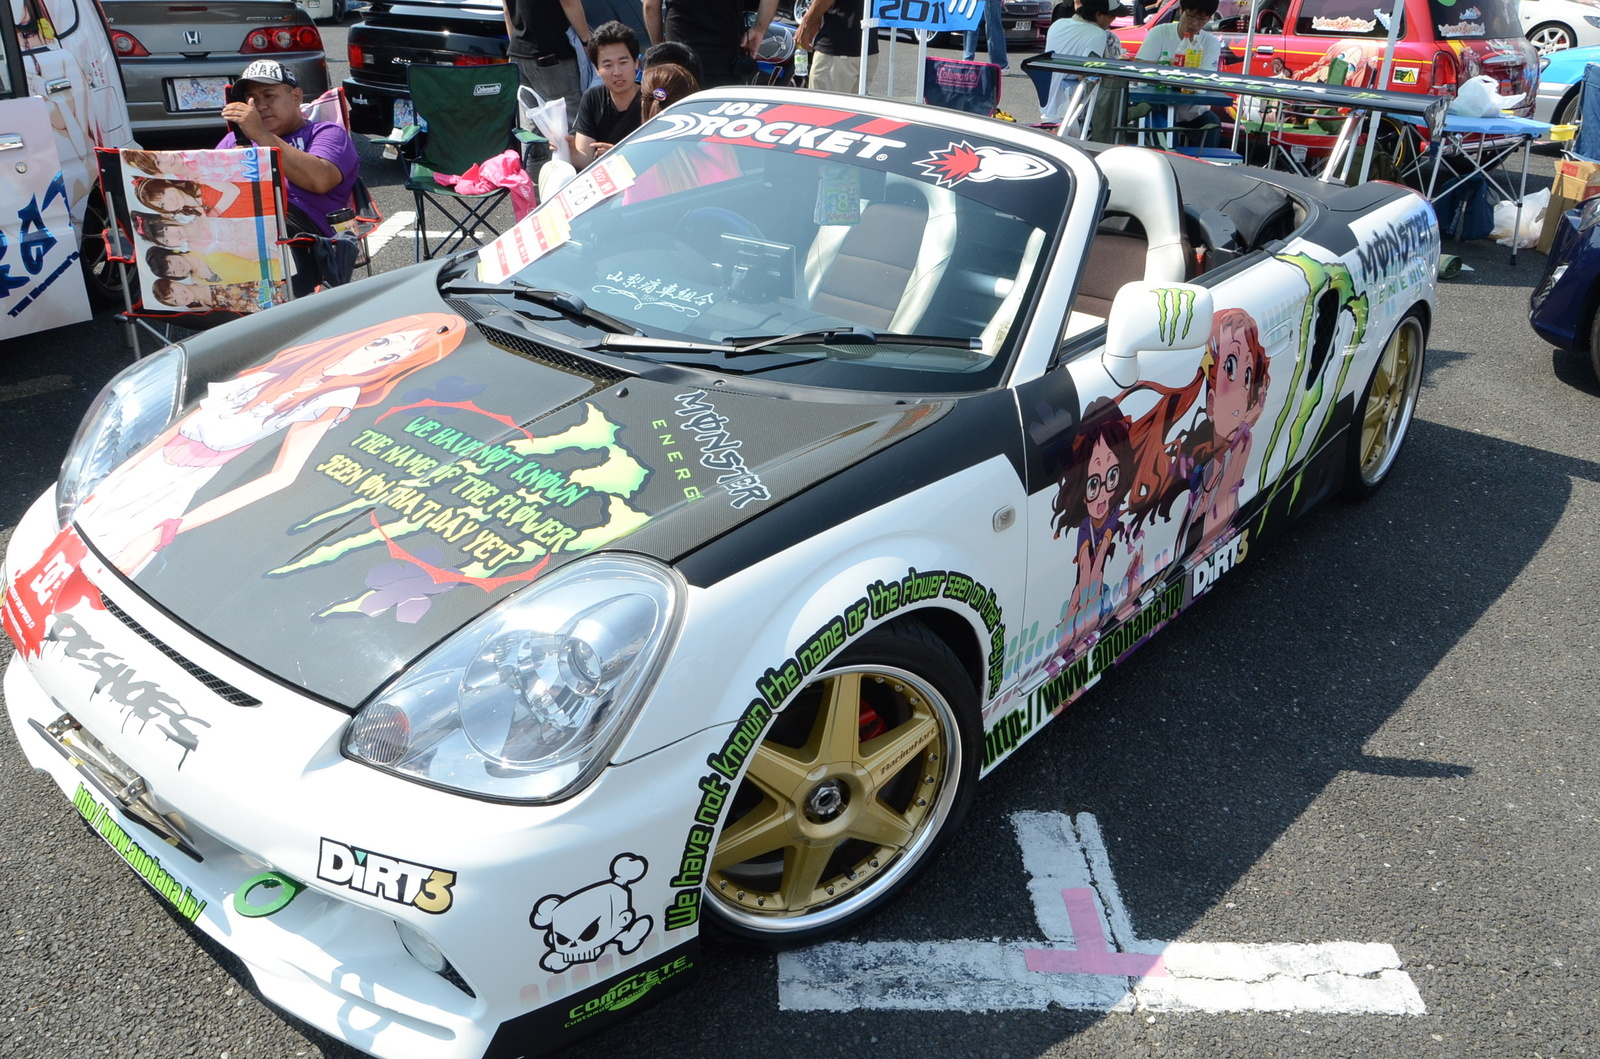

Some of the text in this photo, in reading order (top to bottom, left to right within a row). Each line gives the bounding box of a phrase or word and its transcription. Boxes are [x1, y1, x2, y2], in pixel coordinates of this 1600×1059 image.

[708, 102, 769, 117] JOE
[1356, 209, 1433, 284] MONSTER
[404, 416, 442, 437] WE
[428, 427, 480, 457] HAVE
[510, 461, 590, 507] KNOWN
[674, 389, 772, 509] MONSTER
[316, 454, 520, 568] SEEN ON THAT DAY YET
[351, 429, 395, 456] THE
[379, 444, 439, 477] NAME
[451, 474, 501, 506] THE
[487, 493, 578, 554] FLOWER
[867, 580, 901, 620] the
[945, 571, 973, 605] seen
[971, 583, 987, 611] on
[795, 615, 847, 675] name
[988, 625, 1005, 666] day
[756, 658, 804, 712] the
[706, 697, 772, 780] known
[880, 726, 936, 776] RacingHart
[694, 772, 732, 825] not
[670, 823, 715, 888] have
[665, 888, 702, 931] We
[569, 955, 688, 1019] COMPLETE
